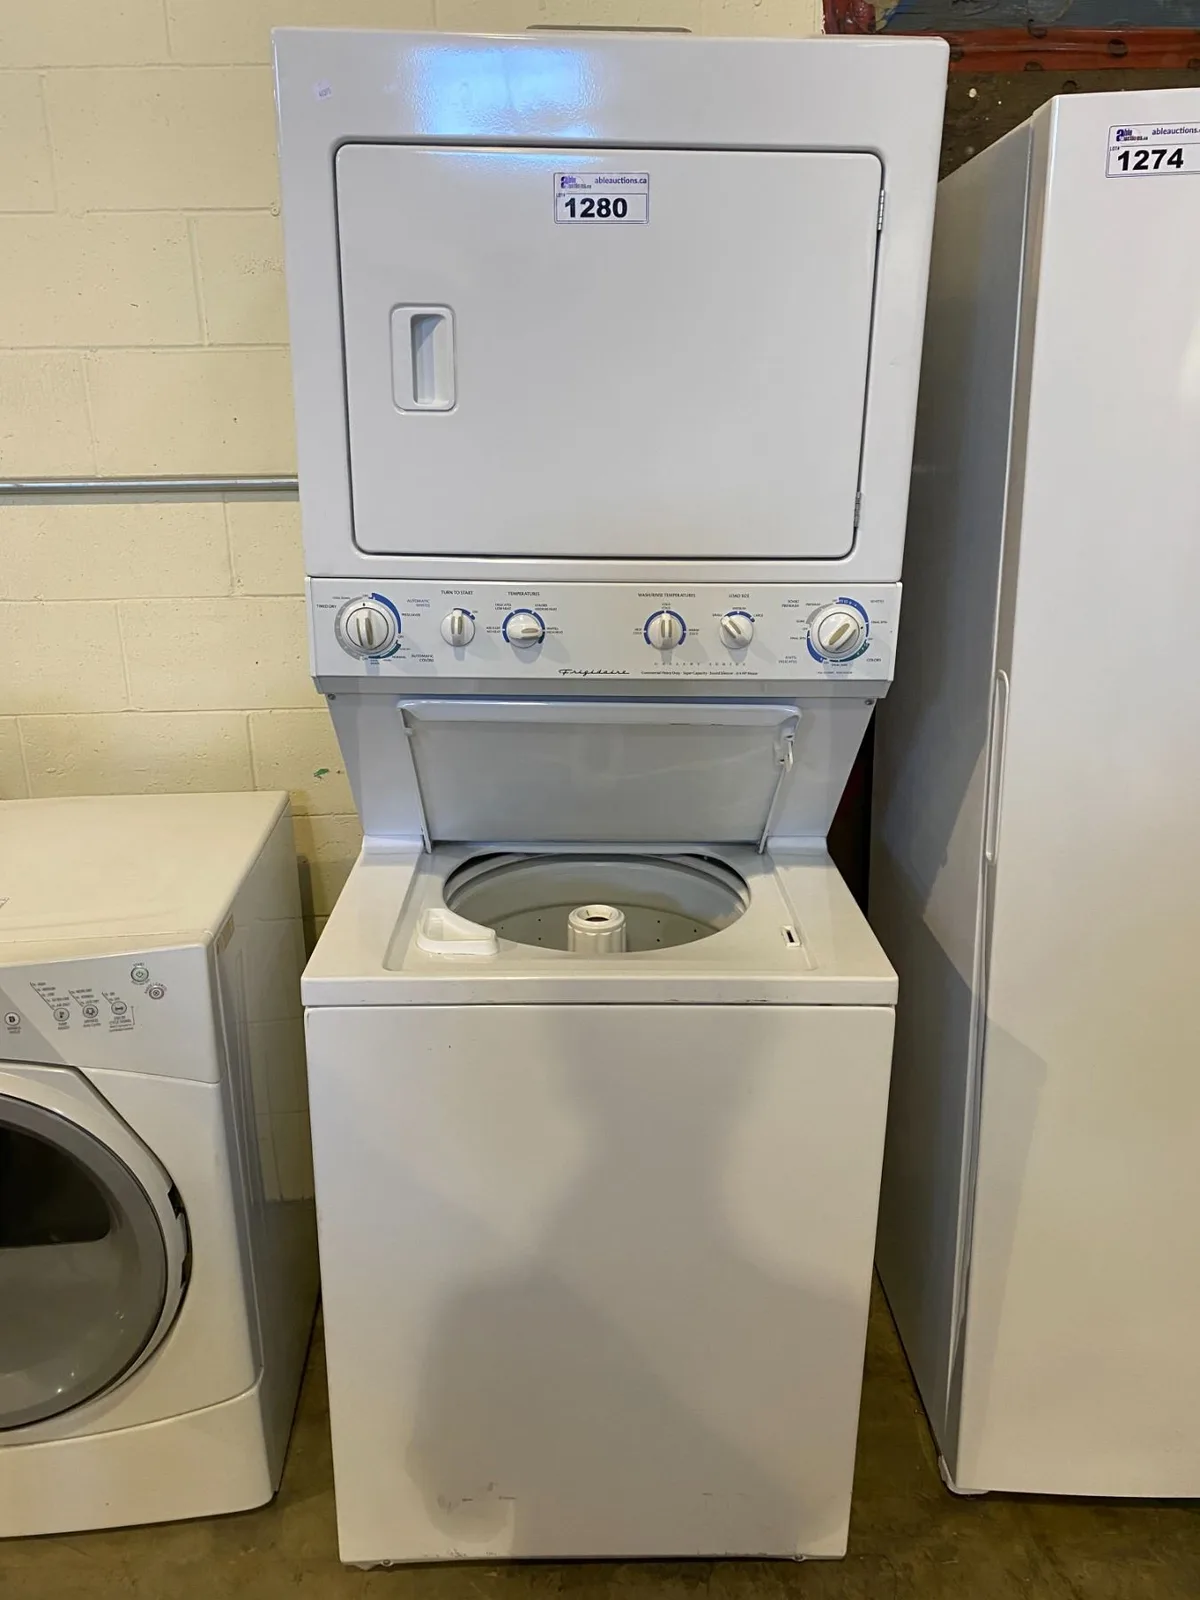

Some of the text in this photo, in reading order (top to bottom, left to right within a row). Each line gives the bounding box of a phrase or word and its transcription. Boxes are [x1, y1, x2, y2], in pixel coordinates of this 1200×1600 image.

[1118, 148, 1184, 171] 1274
[595, 176, 647, 184] ableauctions.ca
[565, 198, 628, 218] 1280
[558, 668, 630, 677] Frigidaire
